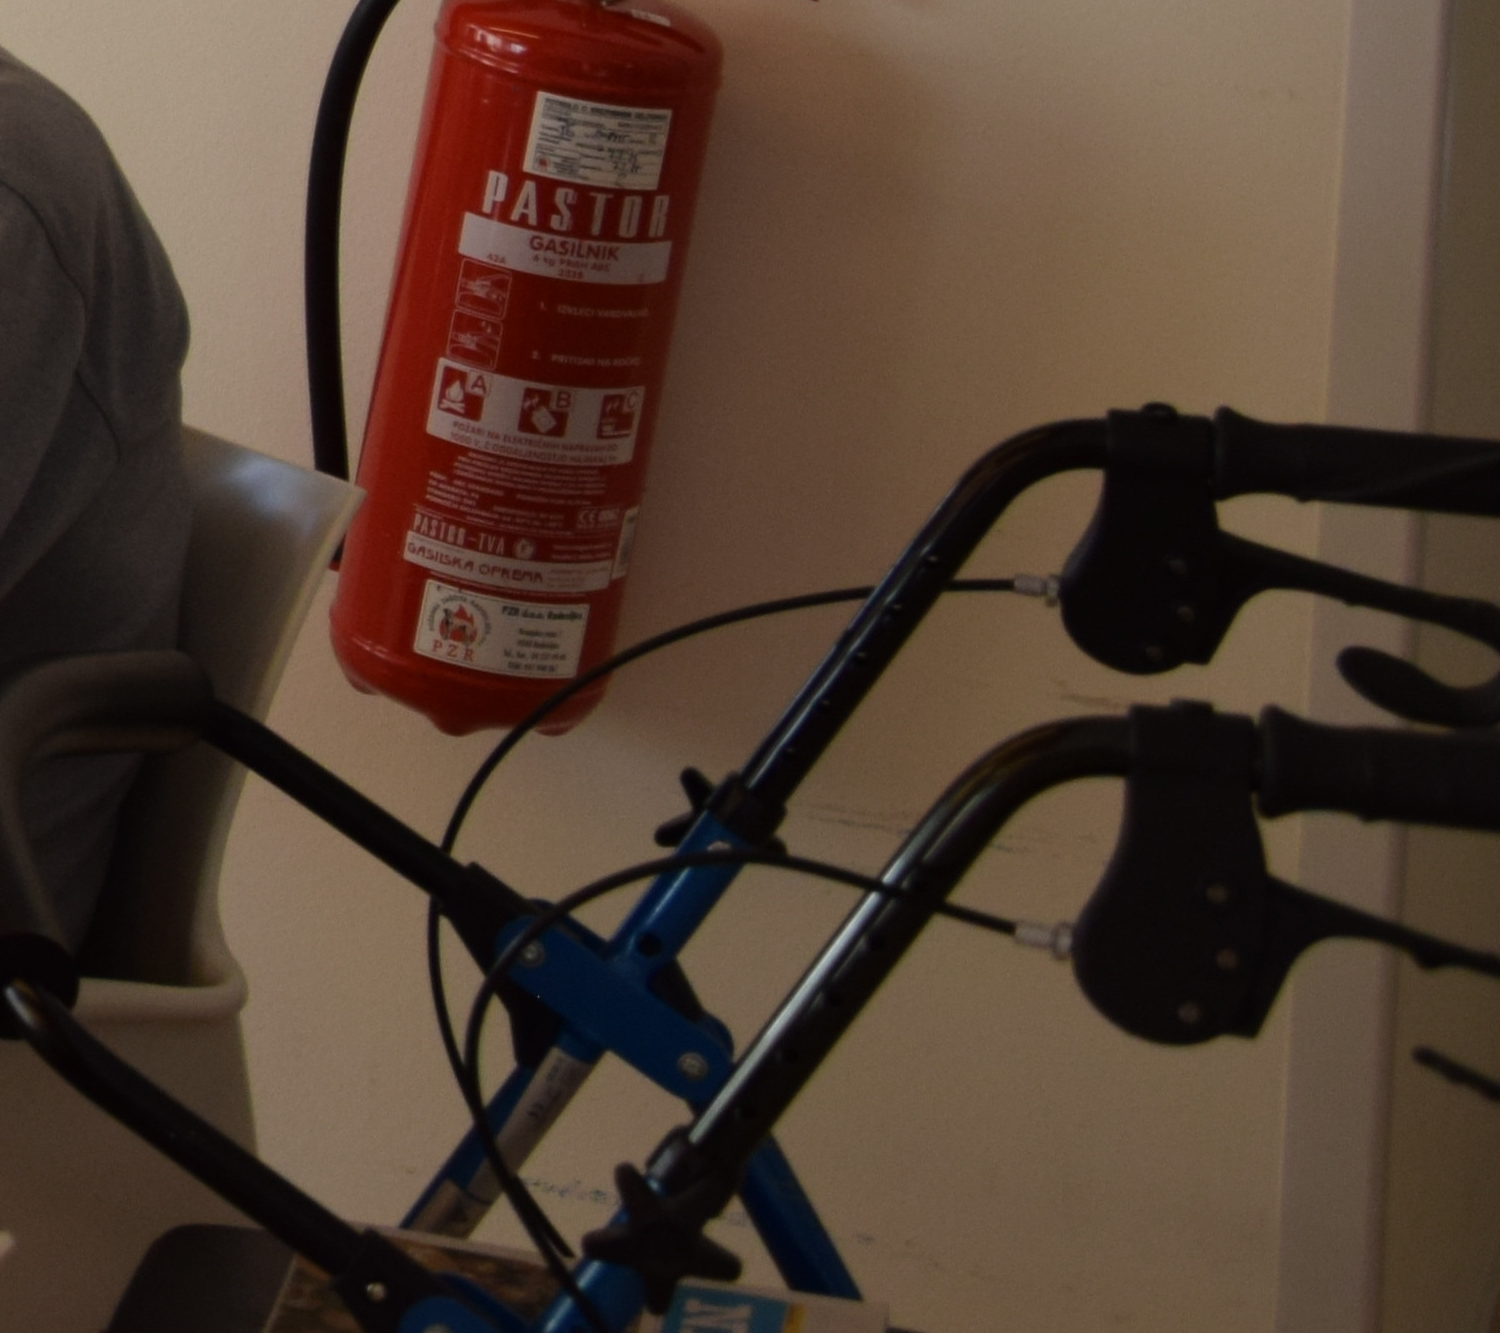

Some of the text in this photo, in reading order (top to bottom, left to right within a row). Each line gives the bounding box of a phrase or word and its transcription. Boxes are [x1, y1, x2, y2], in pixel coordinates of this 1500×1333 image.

[482, 169, 670, 238] PASTOR
[529, 235, 620, 261] GASILNIK
[469, 375, 639, 409] A B C
[407, 541, 544, 584] GASILSKA OPREMA
